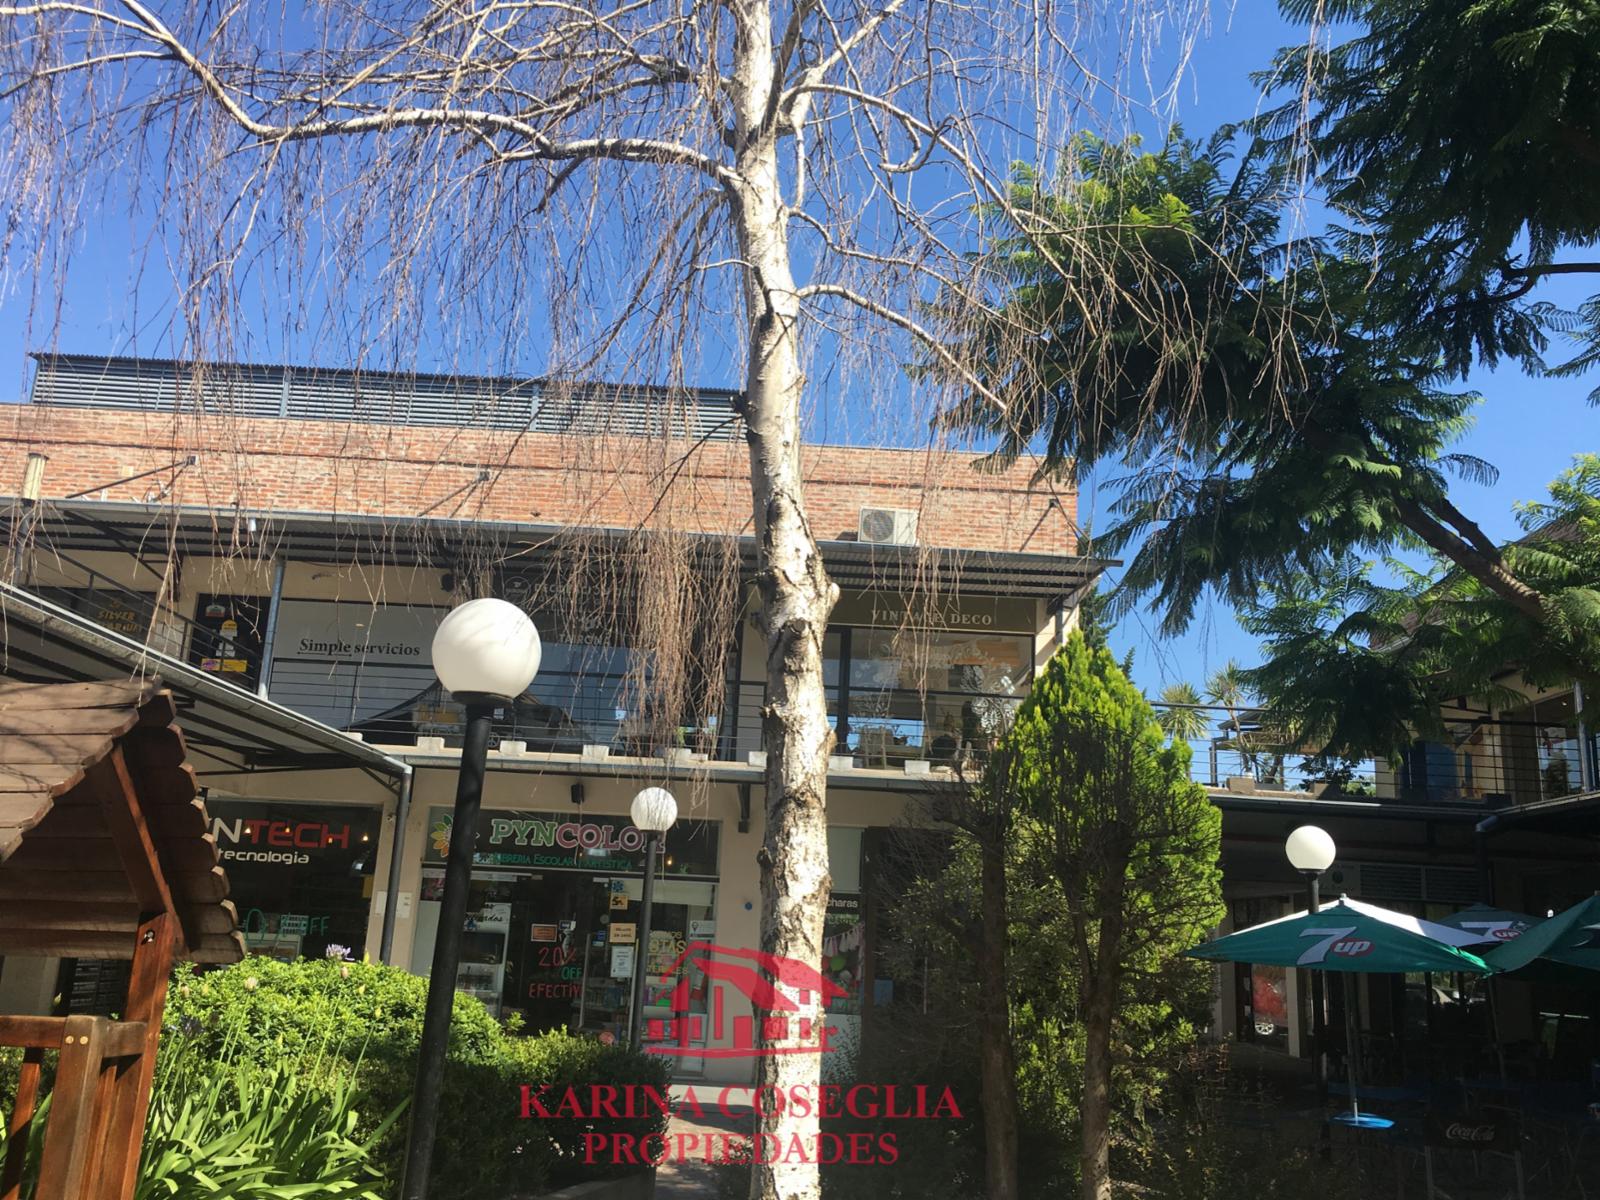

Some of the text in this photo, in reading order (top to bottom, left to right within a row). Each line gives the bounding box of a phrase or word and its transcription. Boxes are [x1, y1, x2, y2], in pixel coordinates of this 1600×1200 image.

[951, 613, 992, 626] DECO
[299, 638, 420, 656] Simple servicios
